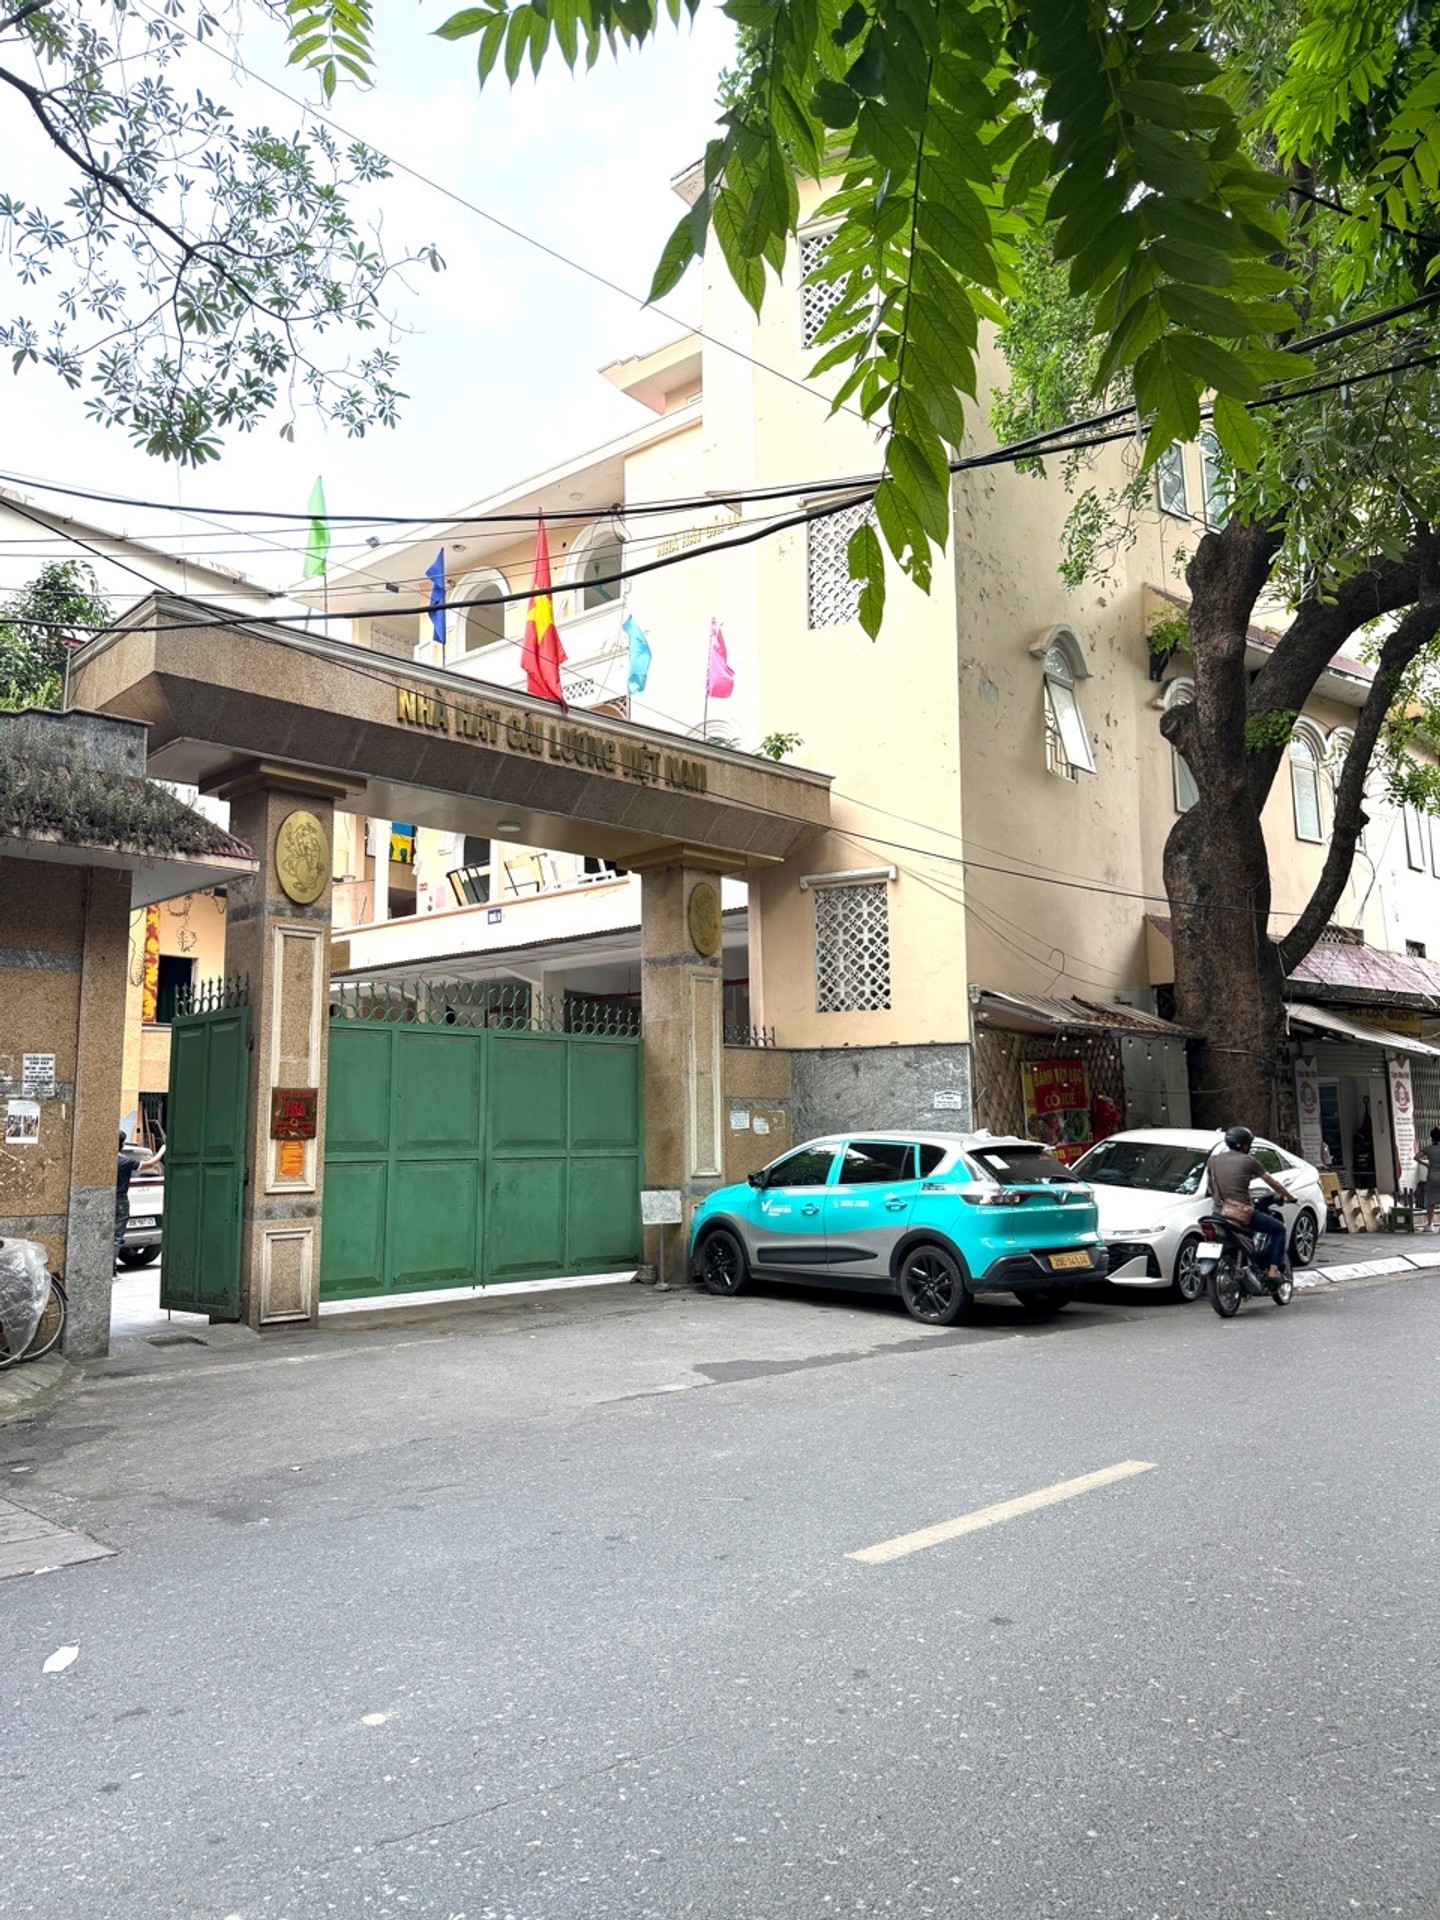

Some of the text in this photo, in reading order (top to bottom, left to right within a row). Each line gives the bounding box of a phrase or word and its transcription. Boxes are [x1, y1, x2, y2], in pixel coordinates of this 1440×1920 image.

[397, 688, 708, 794] NHÀ HÁT CẢI LƯƠNG VIỆT NAM
